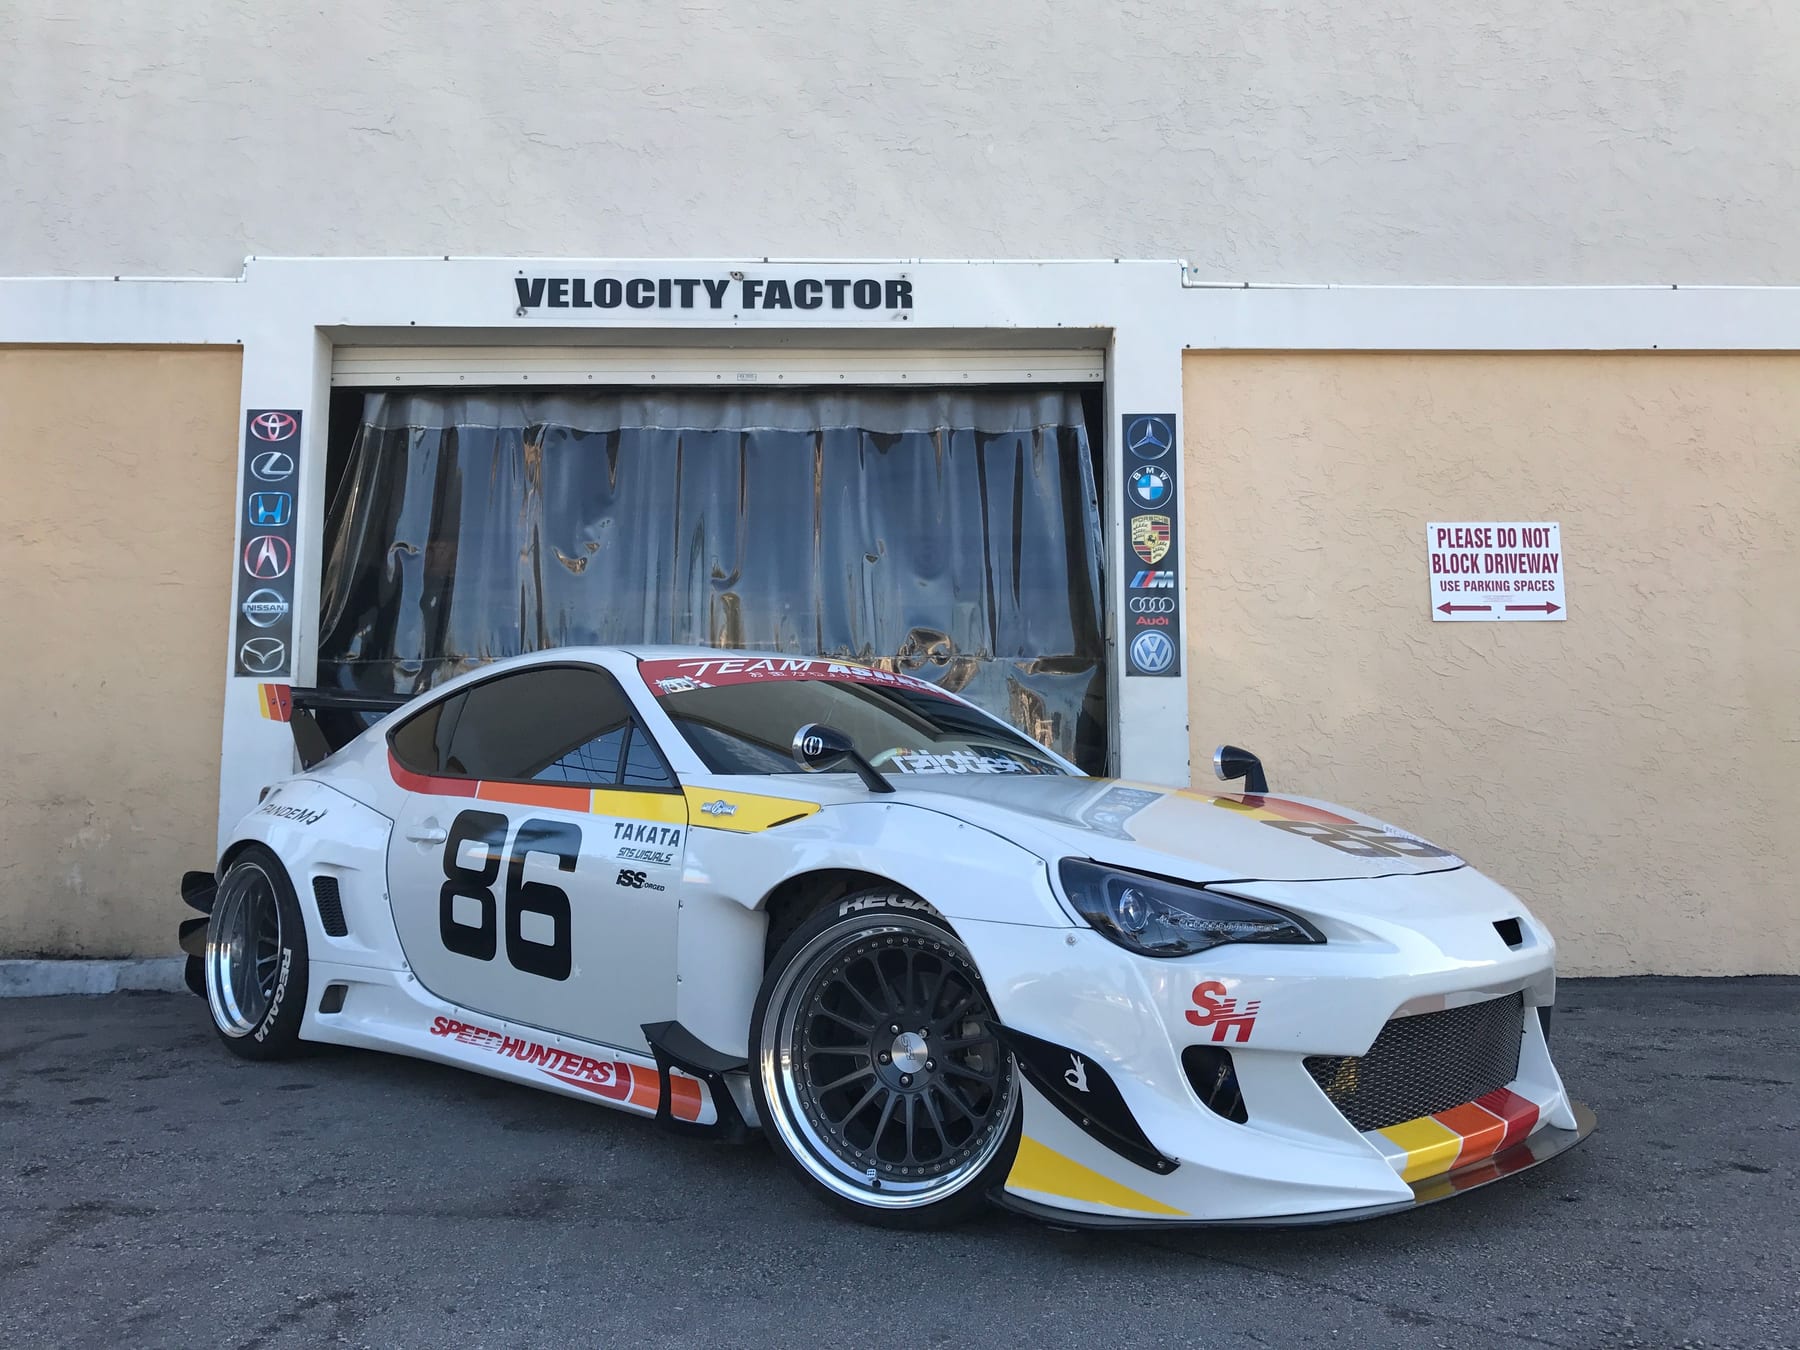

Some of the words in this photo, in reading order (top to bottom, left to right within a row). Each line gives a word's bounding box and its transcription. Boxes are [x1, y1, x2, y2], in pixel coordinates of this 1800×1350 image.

[514, 278, 730, 309] VELOCITY
[742, 279, 913, 309] FACTOR
[1133, 467, 1168, 480] BMW
[1437, 528, 1492, 548] PLEASE
[1497, 528, 1517, 548] DO
[1522, 528, 1550, 548] NOT
[1432, 553, 1480, 574] BLOCK
[1484, 553, 1559, 574] DRIVEWAY
[1440, 580, 1460, 592] USE
[1464, 580, 1510, 592] PARKING
[1513, 580, 1555, 592] SPACES
[1136, 616, 1169, 625] Audi
[678, 659, 813, 677] TEAM
[614, 823, 681, 847] TAKATA
[1260, 820, 1452, 857] 86
[440, 809, 582, 981] 86
[430, 1016, 614, 1082] SPEEDHUNTERS
